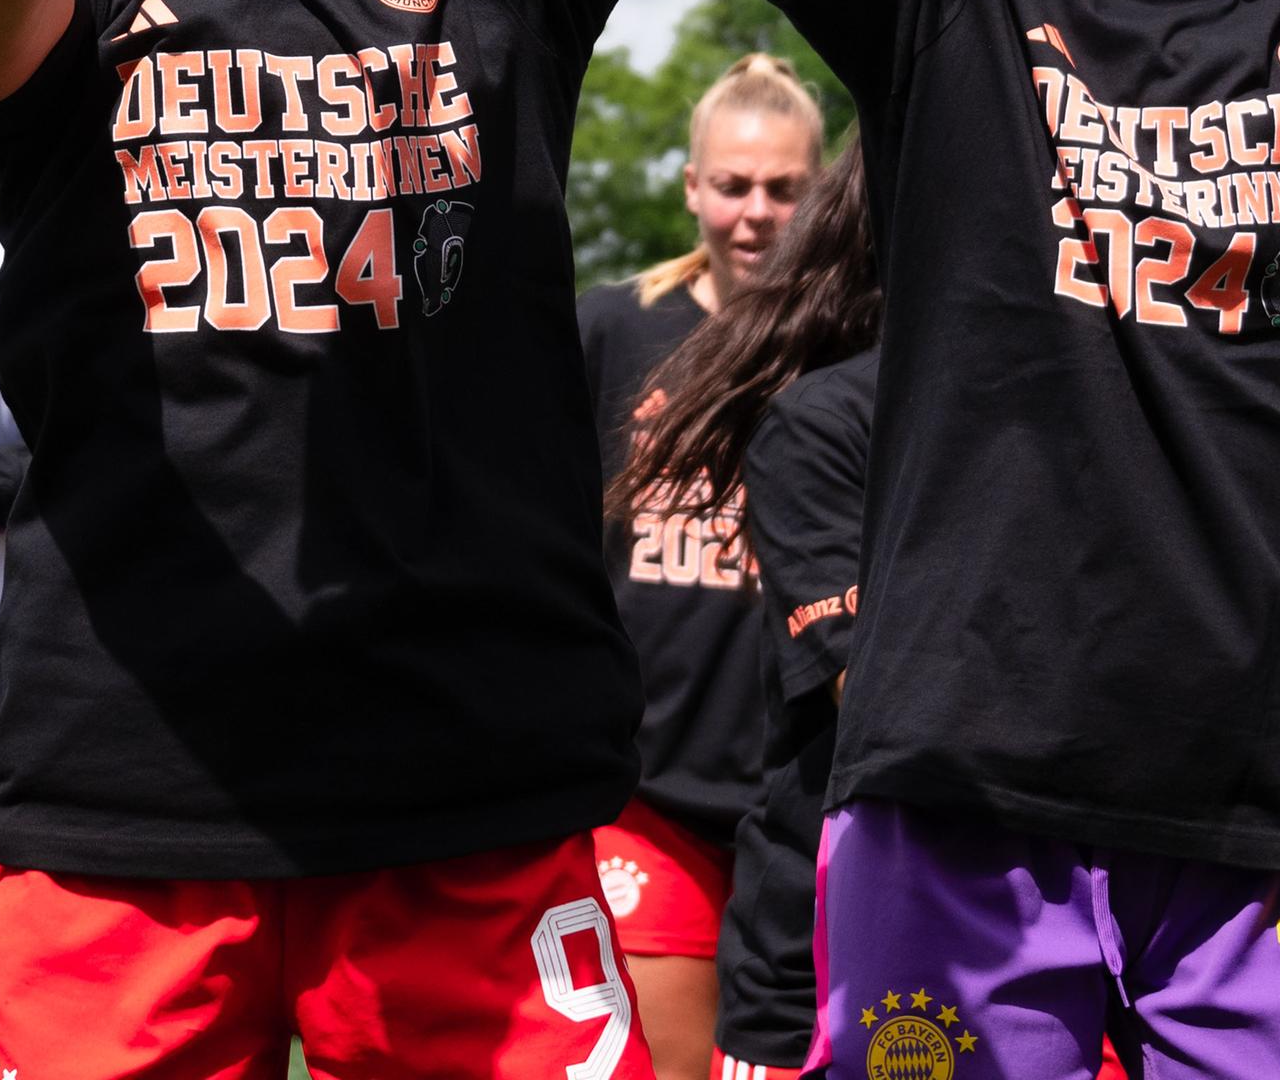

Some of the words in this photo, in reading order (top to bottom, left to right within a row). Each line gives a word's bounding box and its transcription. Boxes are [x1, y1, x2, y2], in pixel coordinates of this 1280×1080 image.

[113, 41, 473, 142] DEUTSCHE
[114, 124, 482, 205] MEISTERINNEN
[128, 206, 403, 333] 2024
[1052, 196, 1257, 334] 2024
[629, 512, 763, 589] 202
[530, 896, 631, 1080] 9
[877, 1030, 895, 1050] FC
[897, 1024, 948, 1064] BAYERN
